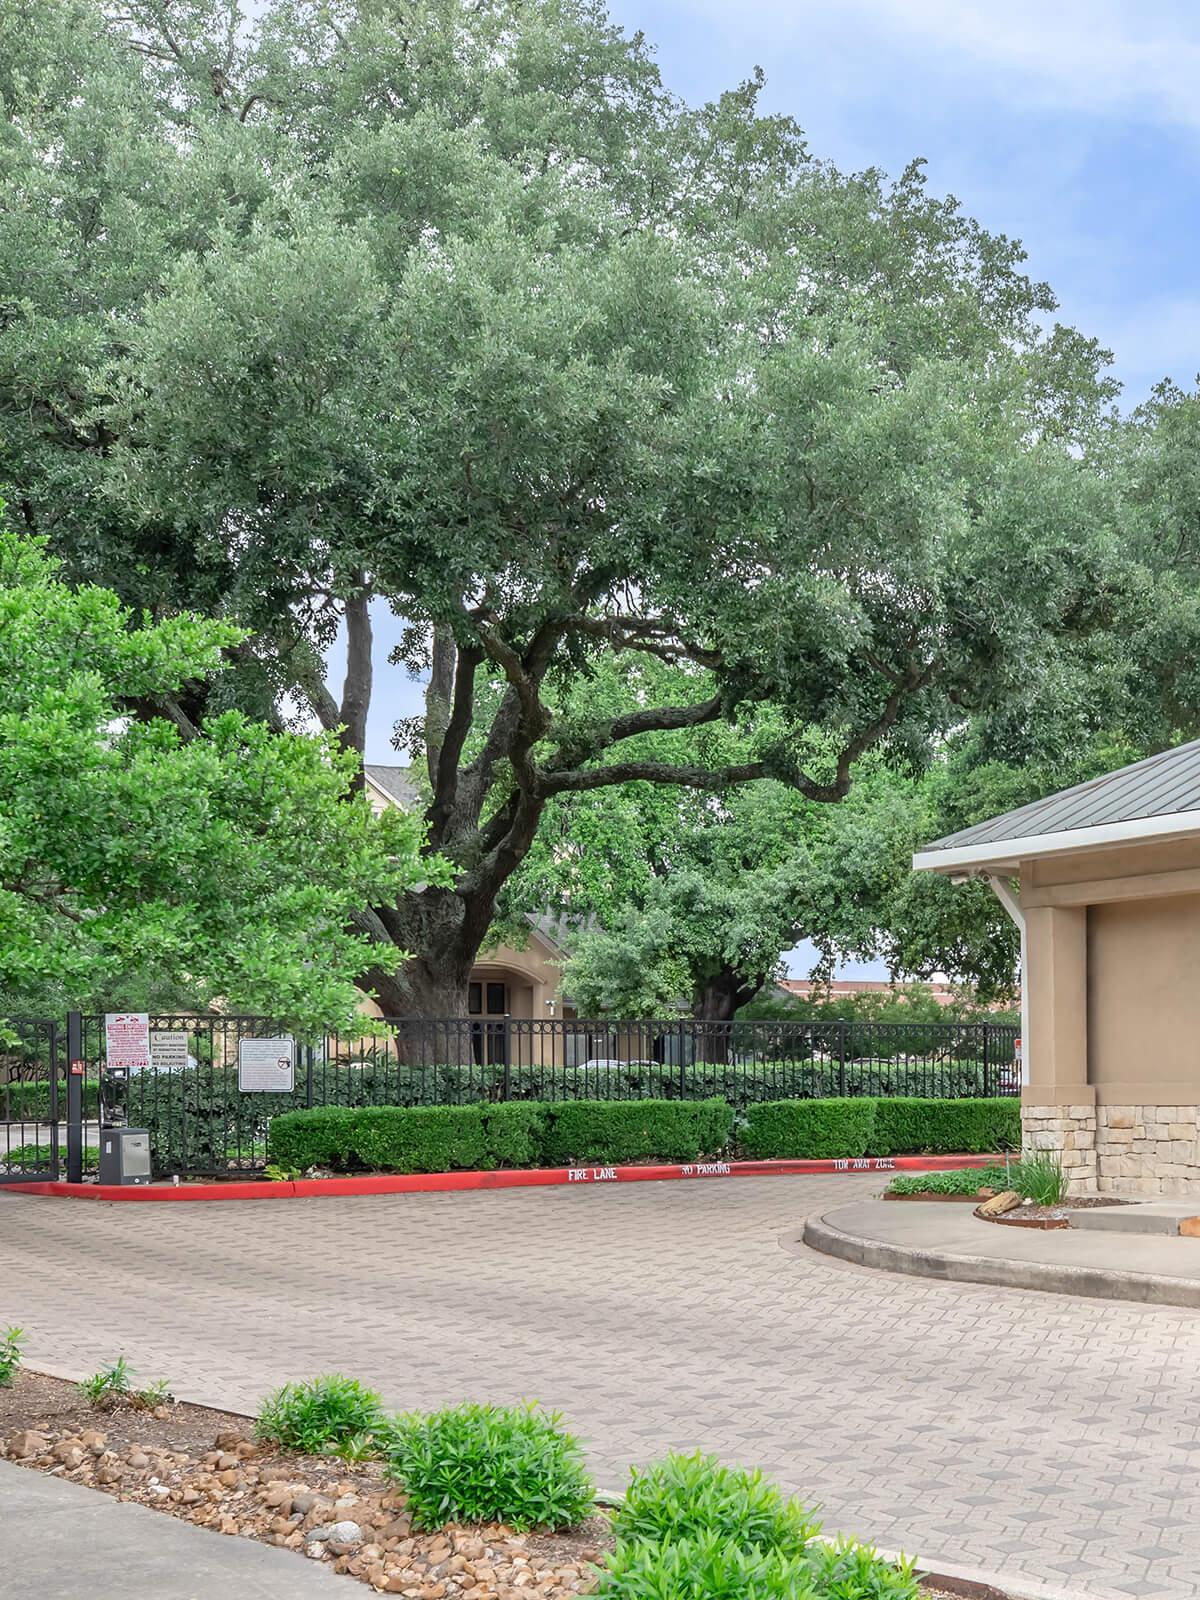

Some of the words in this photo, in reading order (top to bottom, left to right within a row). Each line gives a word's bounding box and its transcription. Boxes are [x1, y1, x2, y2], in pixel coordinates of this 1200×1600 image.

[154, 1033, 184, 1041] Caution
[682, 1166, 693, 1175] NO
[697, 1163, 730, 1174] PARKING
[874, 1157, 895, 1169] ZONE
[568, 1169, 589, 1181] FIRE
[593, 1167, 617, 1180] LANE
